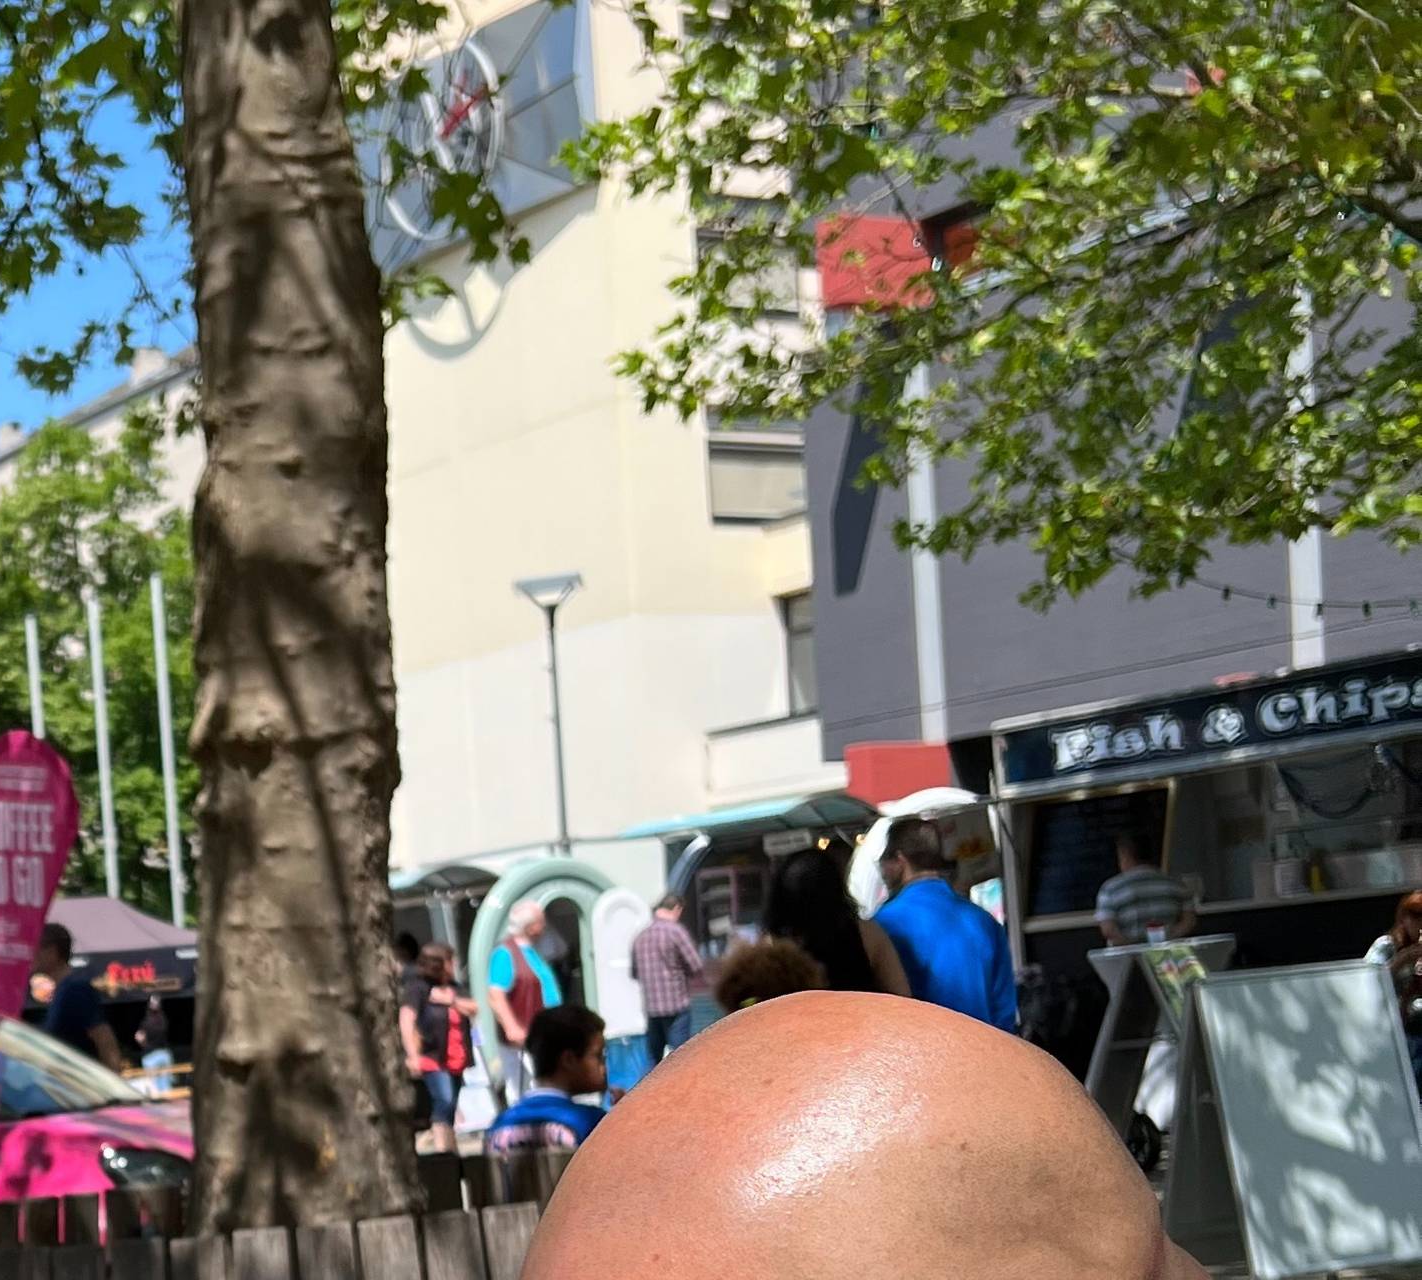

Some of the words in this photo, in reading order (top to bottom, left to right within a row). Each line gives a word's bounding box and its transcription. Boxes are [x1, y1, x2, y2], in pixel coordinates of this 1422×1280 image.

[1050, 711, 1186, 771] Fish
[1200, 705, 1249, 744] &
[12, 857, 44, 908] GO
